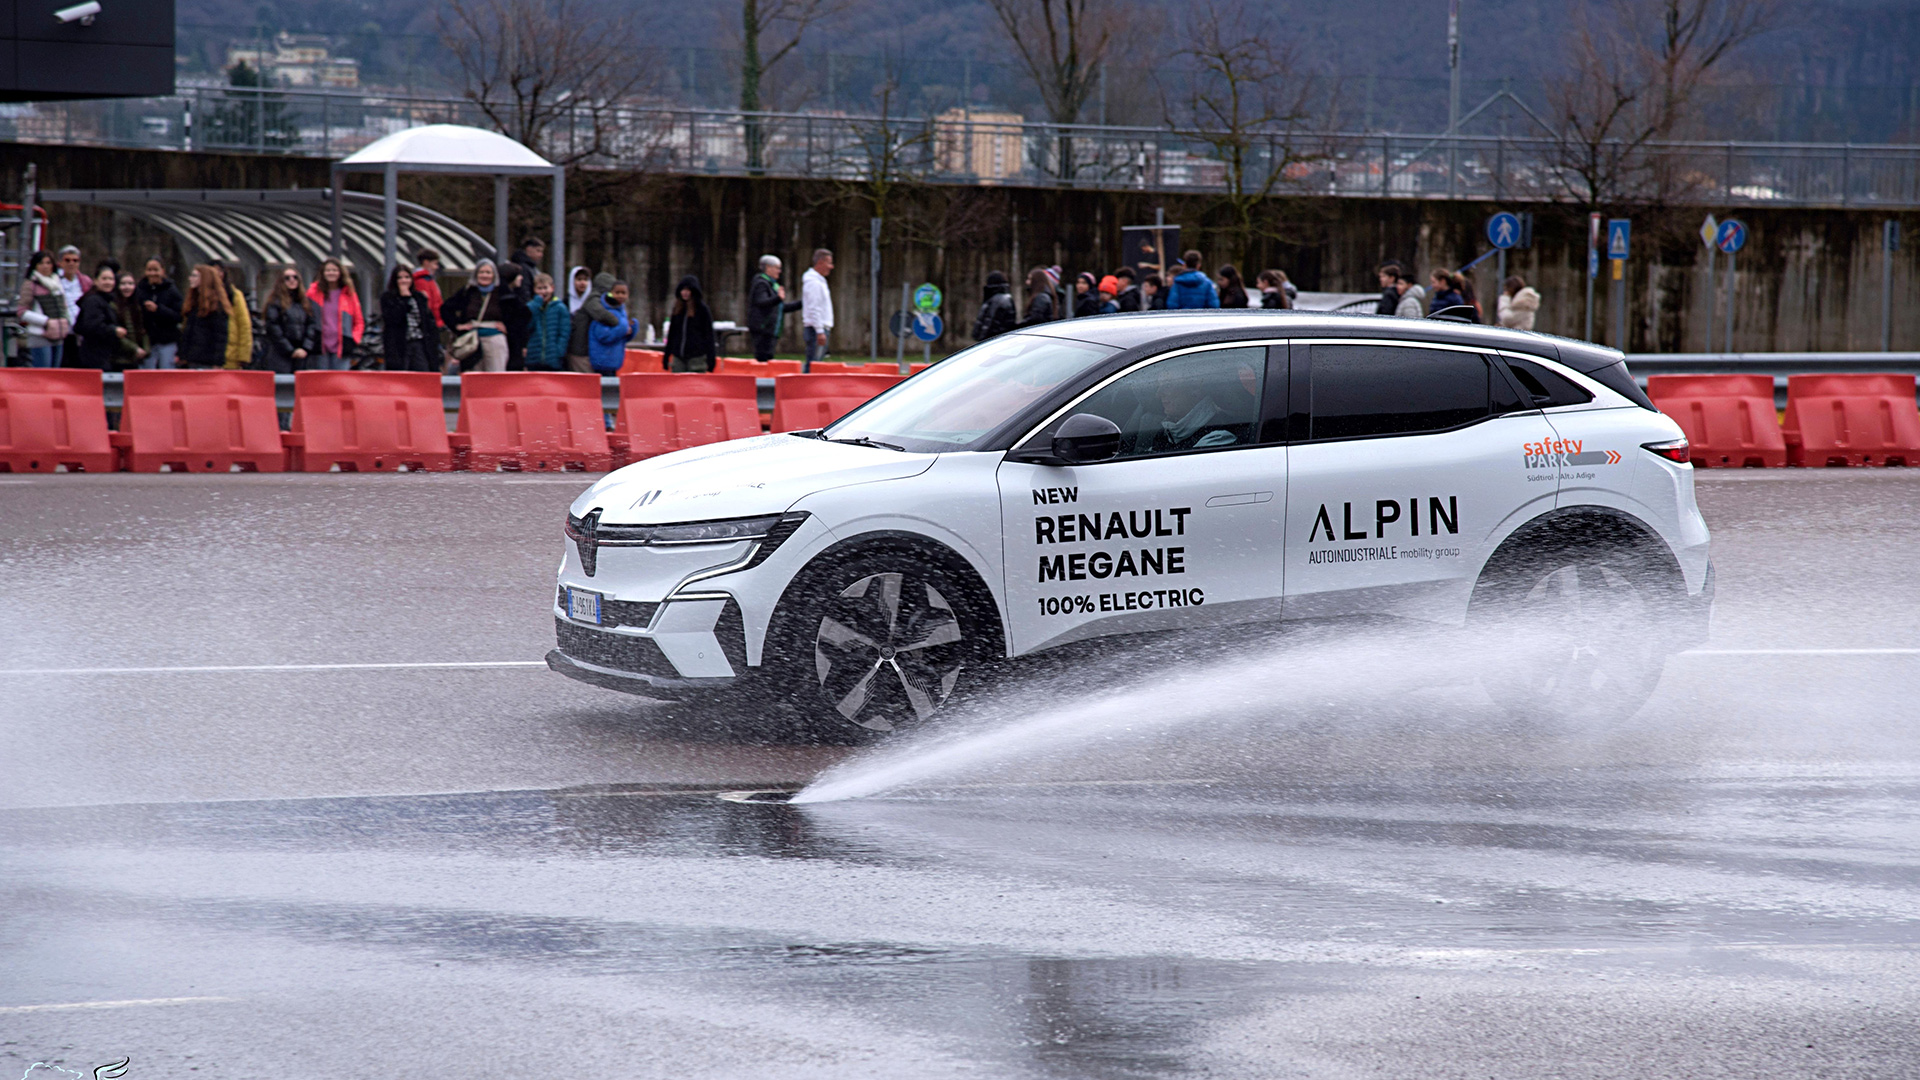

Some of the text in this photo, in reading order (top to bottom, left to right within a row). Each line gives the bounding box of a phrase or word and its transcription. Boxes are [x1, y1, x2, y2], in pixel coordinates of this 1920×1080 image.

[1523, 437, 1583, 456] safety
[1527, 453, 1572, 468] PARK
[1527, 473, 1554, 482] Südtirol
[1576, 472, 1596, 480] Adige
[1032, 486, 1078, 505] NEW
[1035, 507, 1191, 545] RENAULT
[1308, 495, 1459, 543] ALPIN
[1038, 547, 1185, 583] MEGANE
[1309, 546, 1460, 565] AUTOINDUSTRIALE mobility group
[1038, 587, 1205, 616] 100% ELECTRIC
